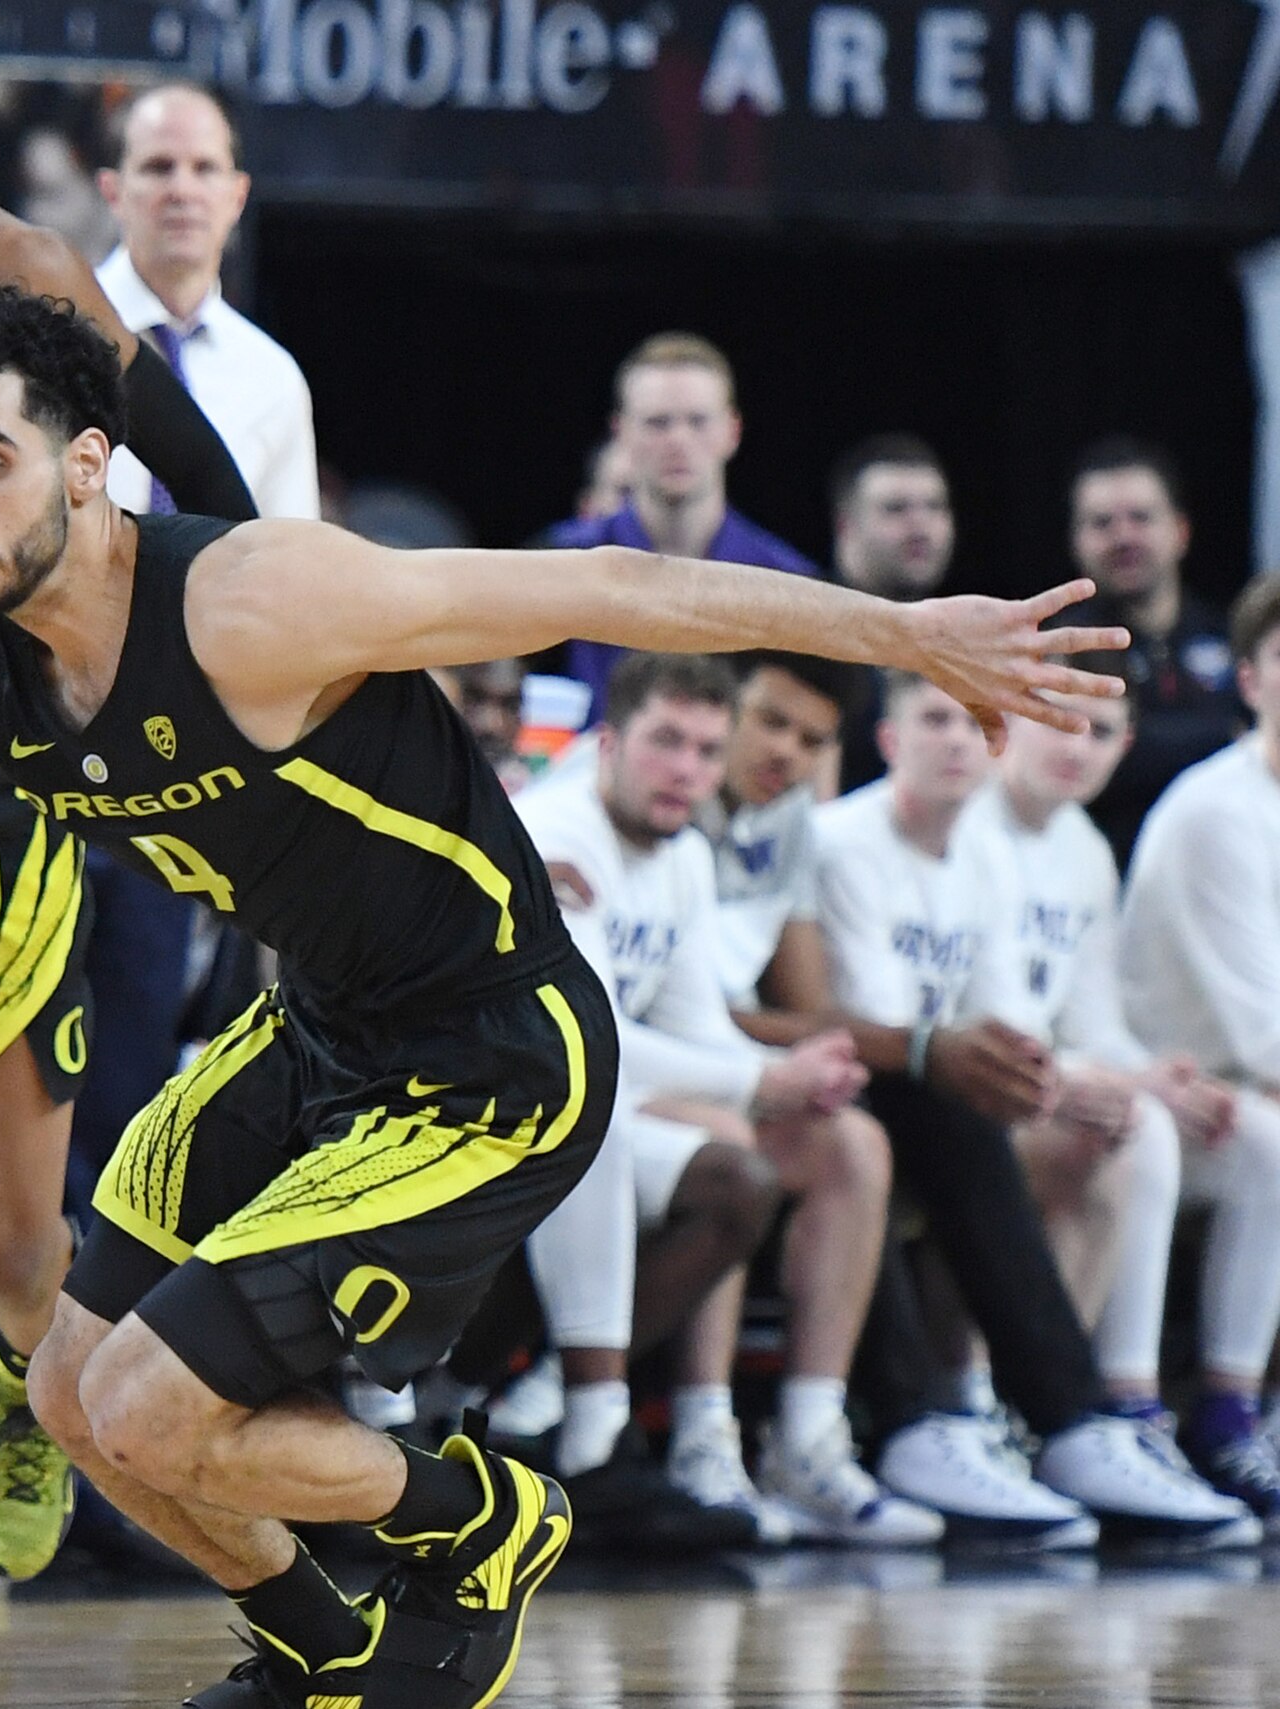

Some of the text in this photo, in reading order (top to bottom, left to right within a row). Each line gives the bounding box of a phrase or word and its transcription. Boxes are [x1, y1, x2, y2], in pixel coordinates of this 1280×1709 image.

[699, 3, 1202, 128] ARENA
[14, 766, 246, 820] OREGON
[130, 833, 236, 912] 4
